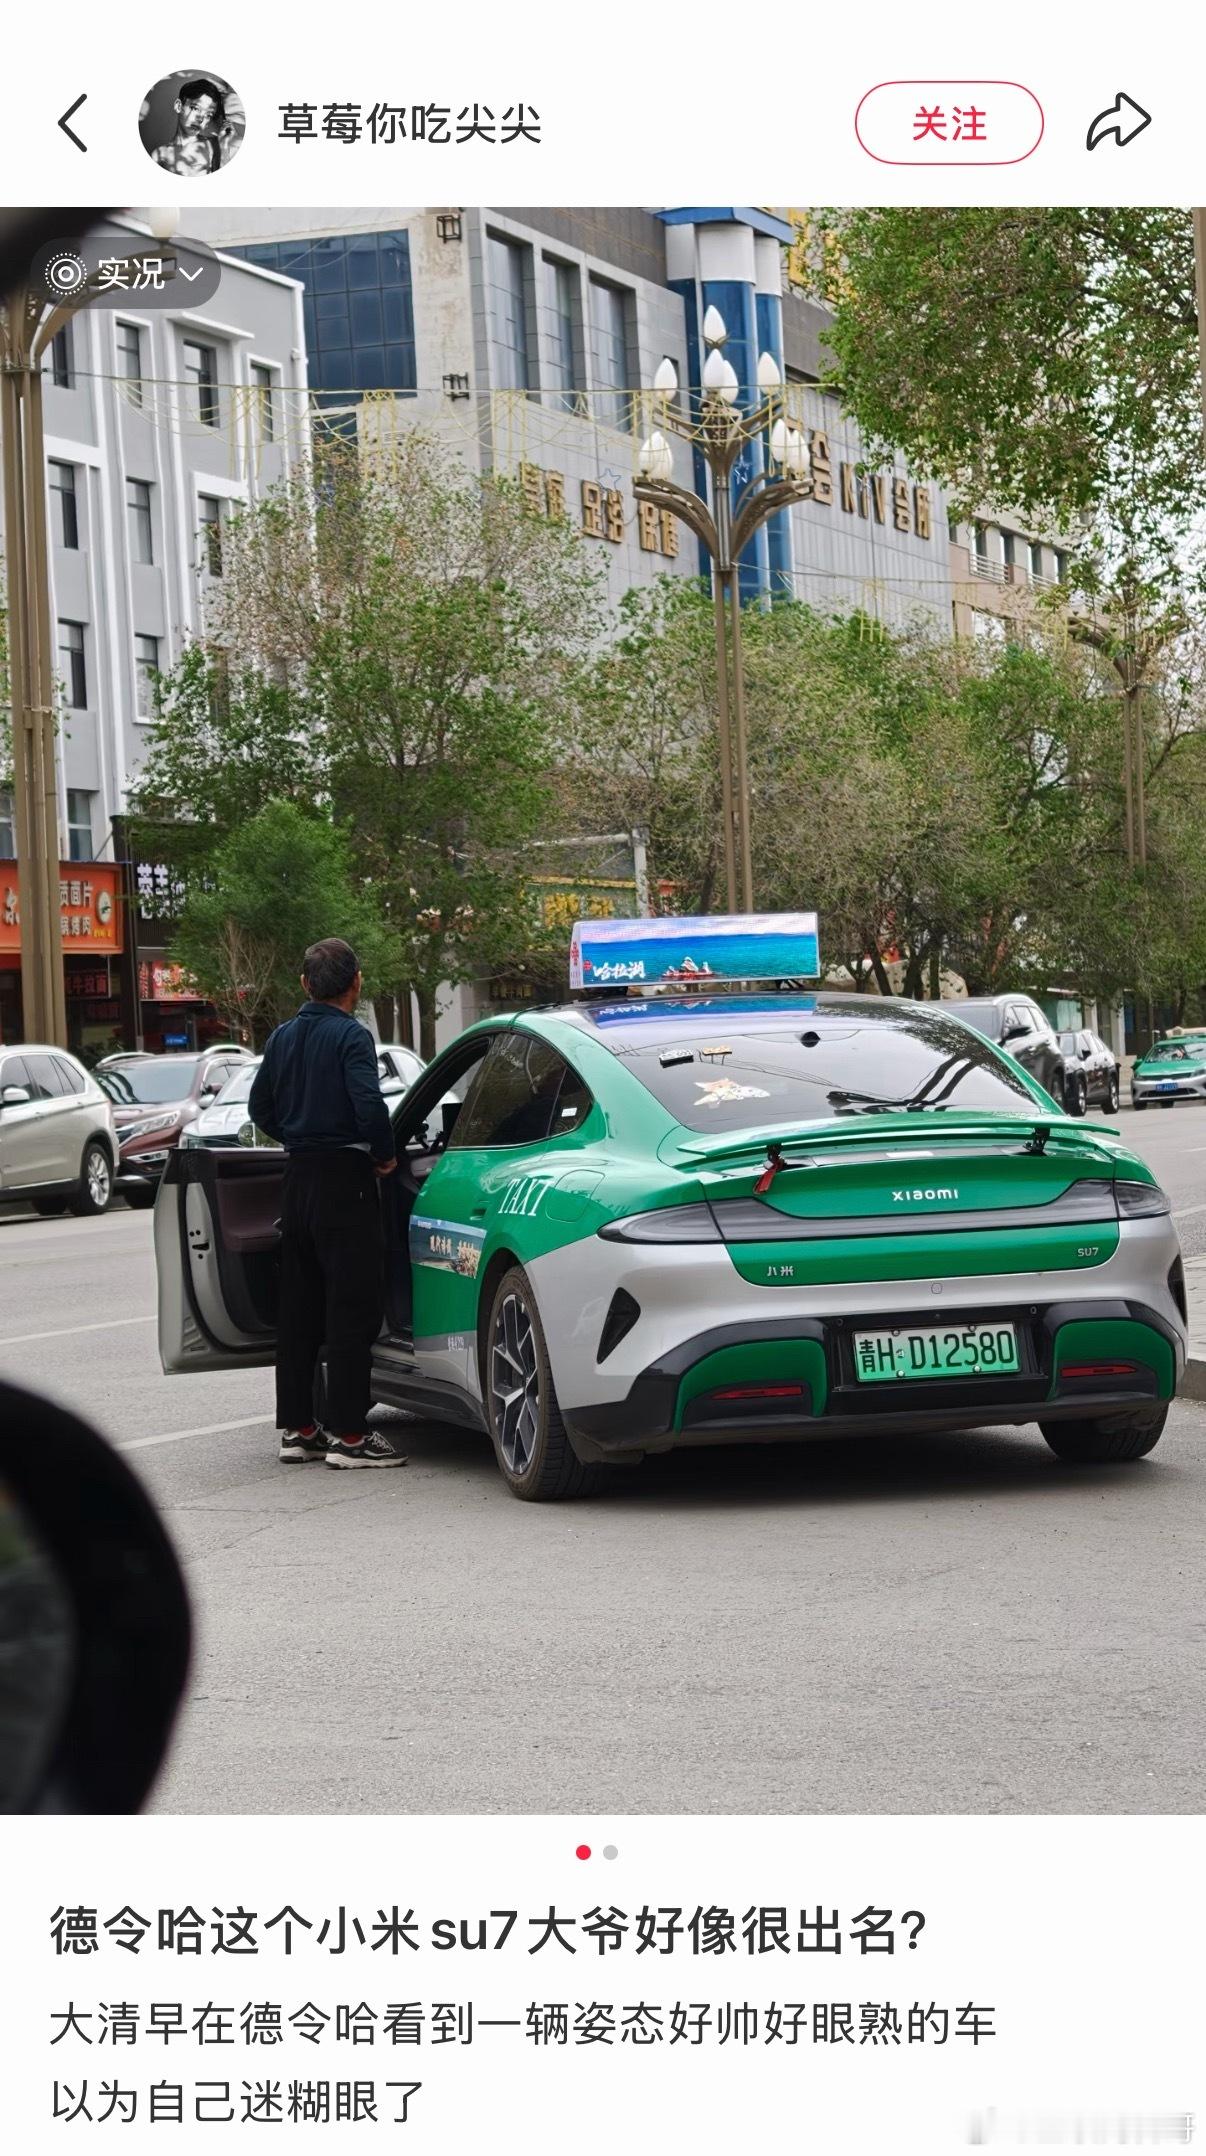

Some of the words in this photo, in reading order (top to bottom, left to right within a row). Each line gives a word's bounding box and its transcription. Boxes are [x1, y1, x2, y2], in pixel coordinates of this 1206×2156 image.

[592, 961, 646, 980] 哈拉湖
[498, 1177, 555, 1216] TAXI
[1077, 1247, 1099, 1257] SU7
